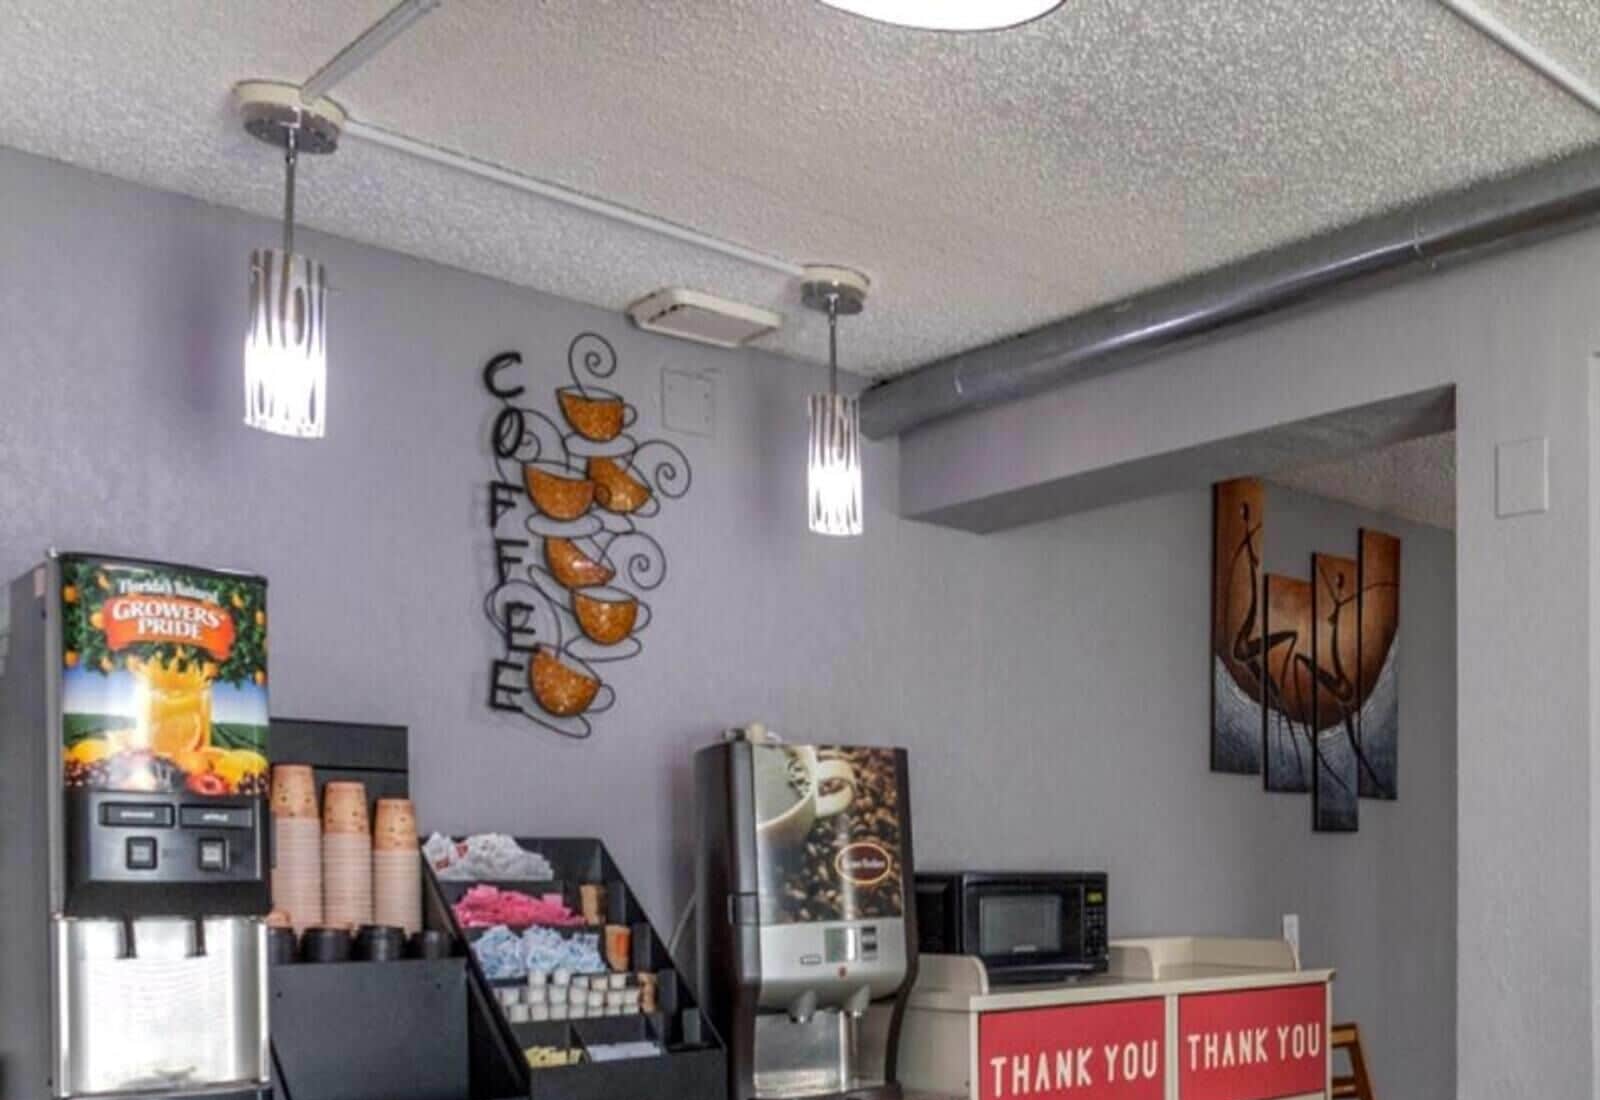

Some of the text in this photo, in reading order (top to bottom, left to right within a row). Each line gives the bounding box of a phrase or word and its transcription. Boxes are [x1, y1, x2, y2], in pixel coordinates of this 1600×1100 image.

[483, 351, 540, 712] COFFEE
[137, 617, 202, 640] PRIDE
[991, 1040, 1160, 1098] THANK YOU
[1187, 1022, 1321, 1071] THANK YOU
